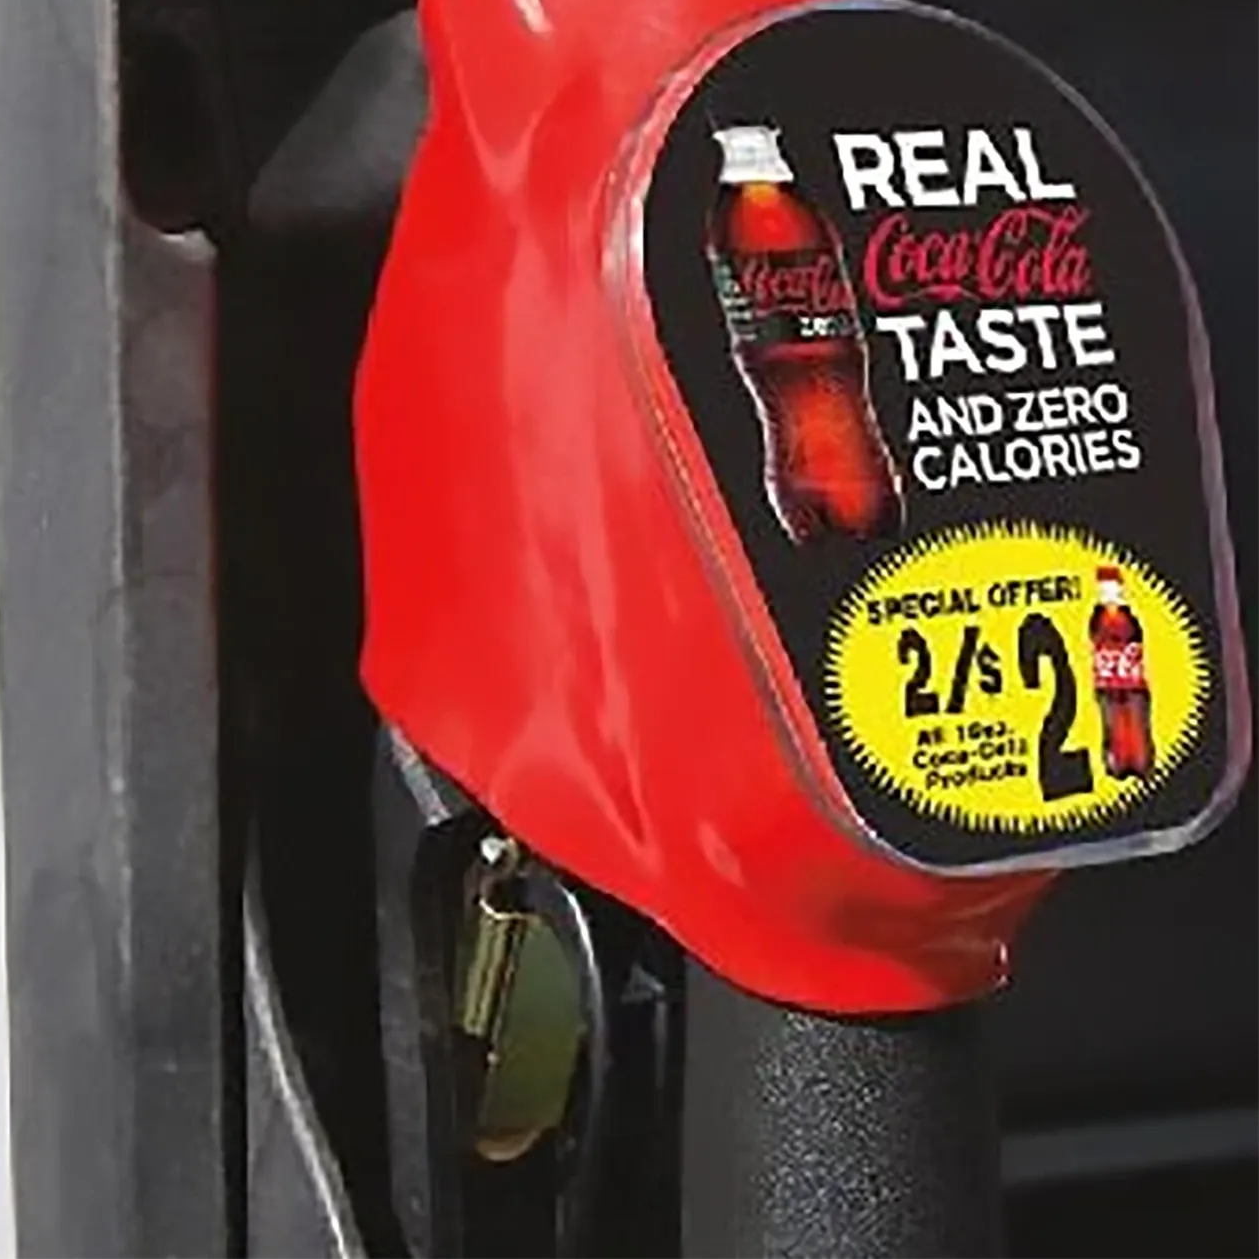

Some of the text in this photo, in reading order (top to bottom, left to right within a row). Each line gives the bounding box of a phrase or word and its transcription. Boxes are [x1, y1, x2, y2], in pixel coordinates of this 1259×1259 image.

[833, 127, 1077, 210] REAL
[875, 302, 1116, 381] TASTE
[908, 383, 1129, 441] AND ZERO
[912, 428, 1142, 491] CALORIES
[866, 574, 1082, 626] SPECIAL OFFER!
